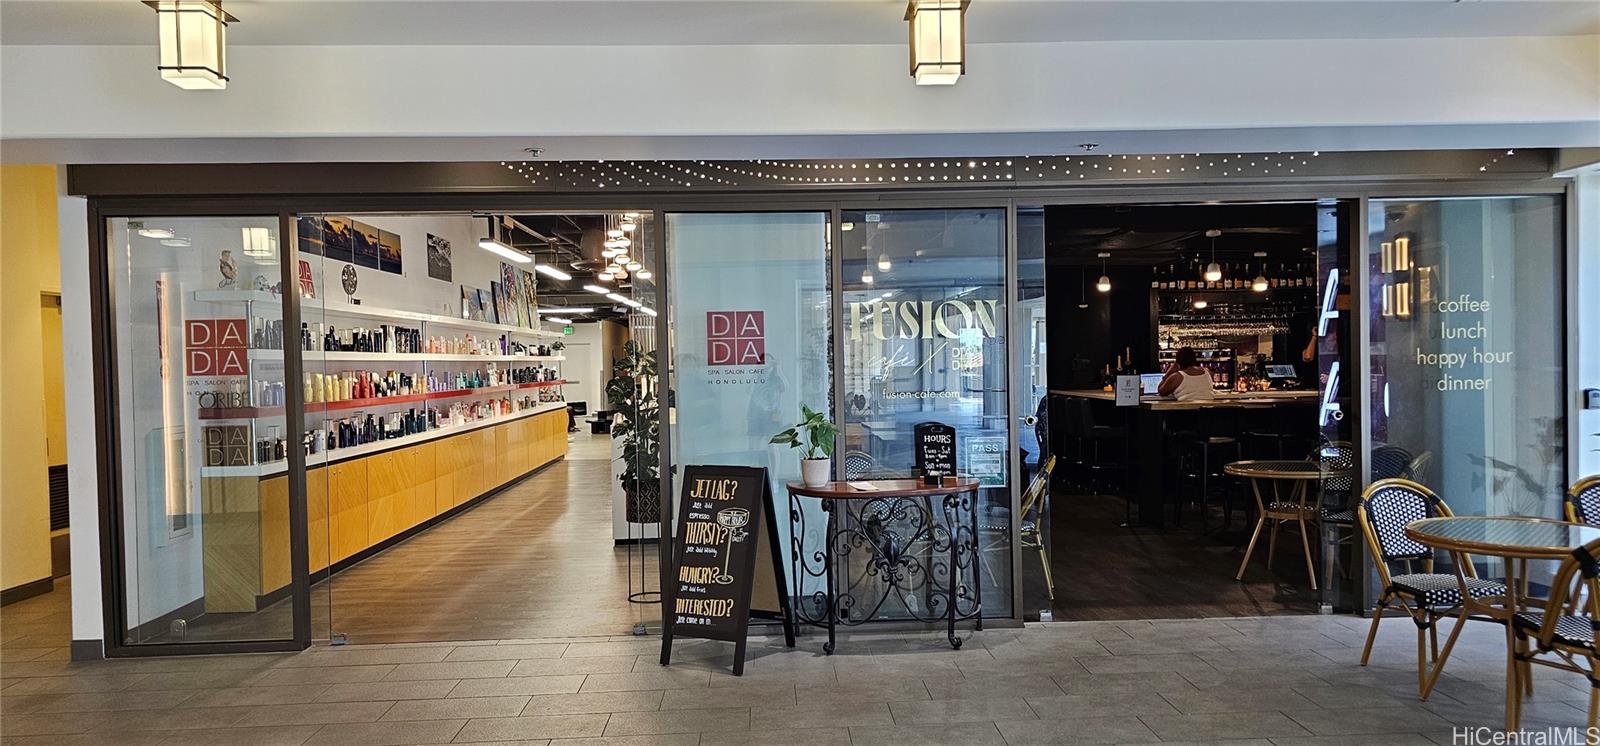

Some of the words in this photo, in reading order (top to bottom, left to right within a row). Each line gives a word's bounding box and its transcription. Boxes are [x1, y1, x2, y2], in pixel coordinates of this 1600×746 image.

[1438, 295, 1490, 313] coffee
[712, 313, 760, 336] DA
[850, 299, 998, 341] FUSION
[190, 322, 242, 346] DA
[1441, 321, 1487, 339] lunch
[712, 341, 761, 364] DA
[1416, 348, 1466, 369] happy
[1473, 346, 1513, 364] hour
[191, 350, 244, 374] DA
[1437, 373, 1492, 391] dinner
[882, 388, 960, 400] fusion-cafe.com
[209, 427, 246, 445] DA
[923, 434, 952, 444] HOURS
[209, 448, 247, 466] DA
[971, 444, 999, 453] PASS
[685, 521, 728, 545] THIRSTY?
[678, 566, 720, 584] HUNGRY?
[675, 598, 734, 617] INTERESTED?
